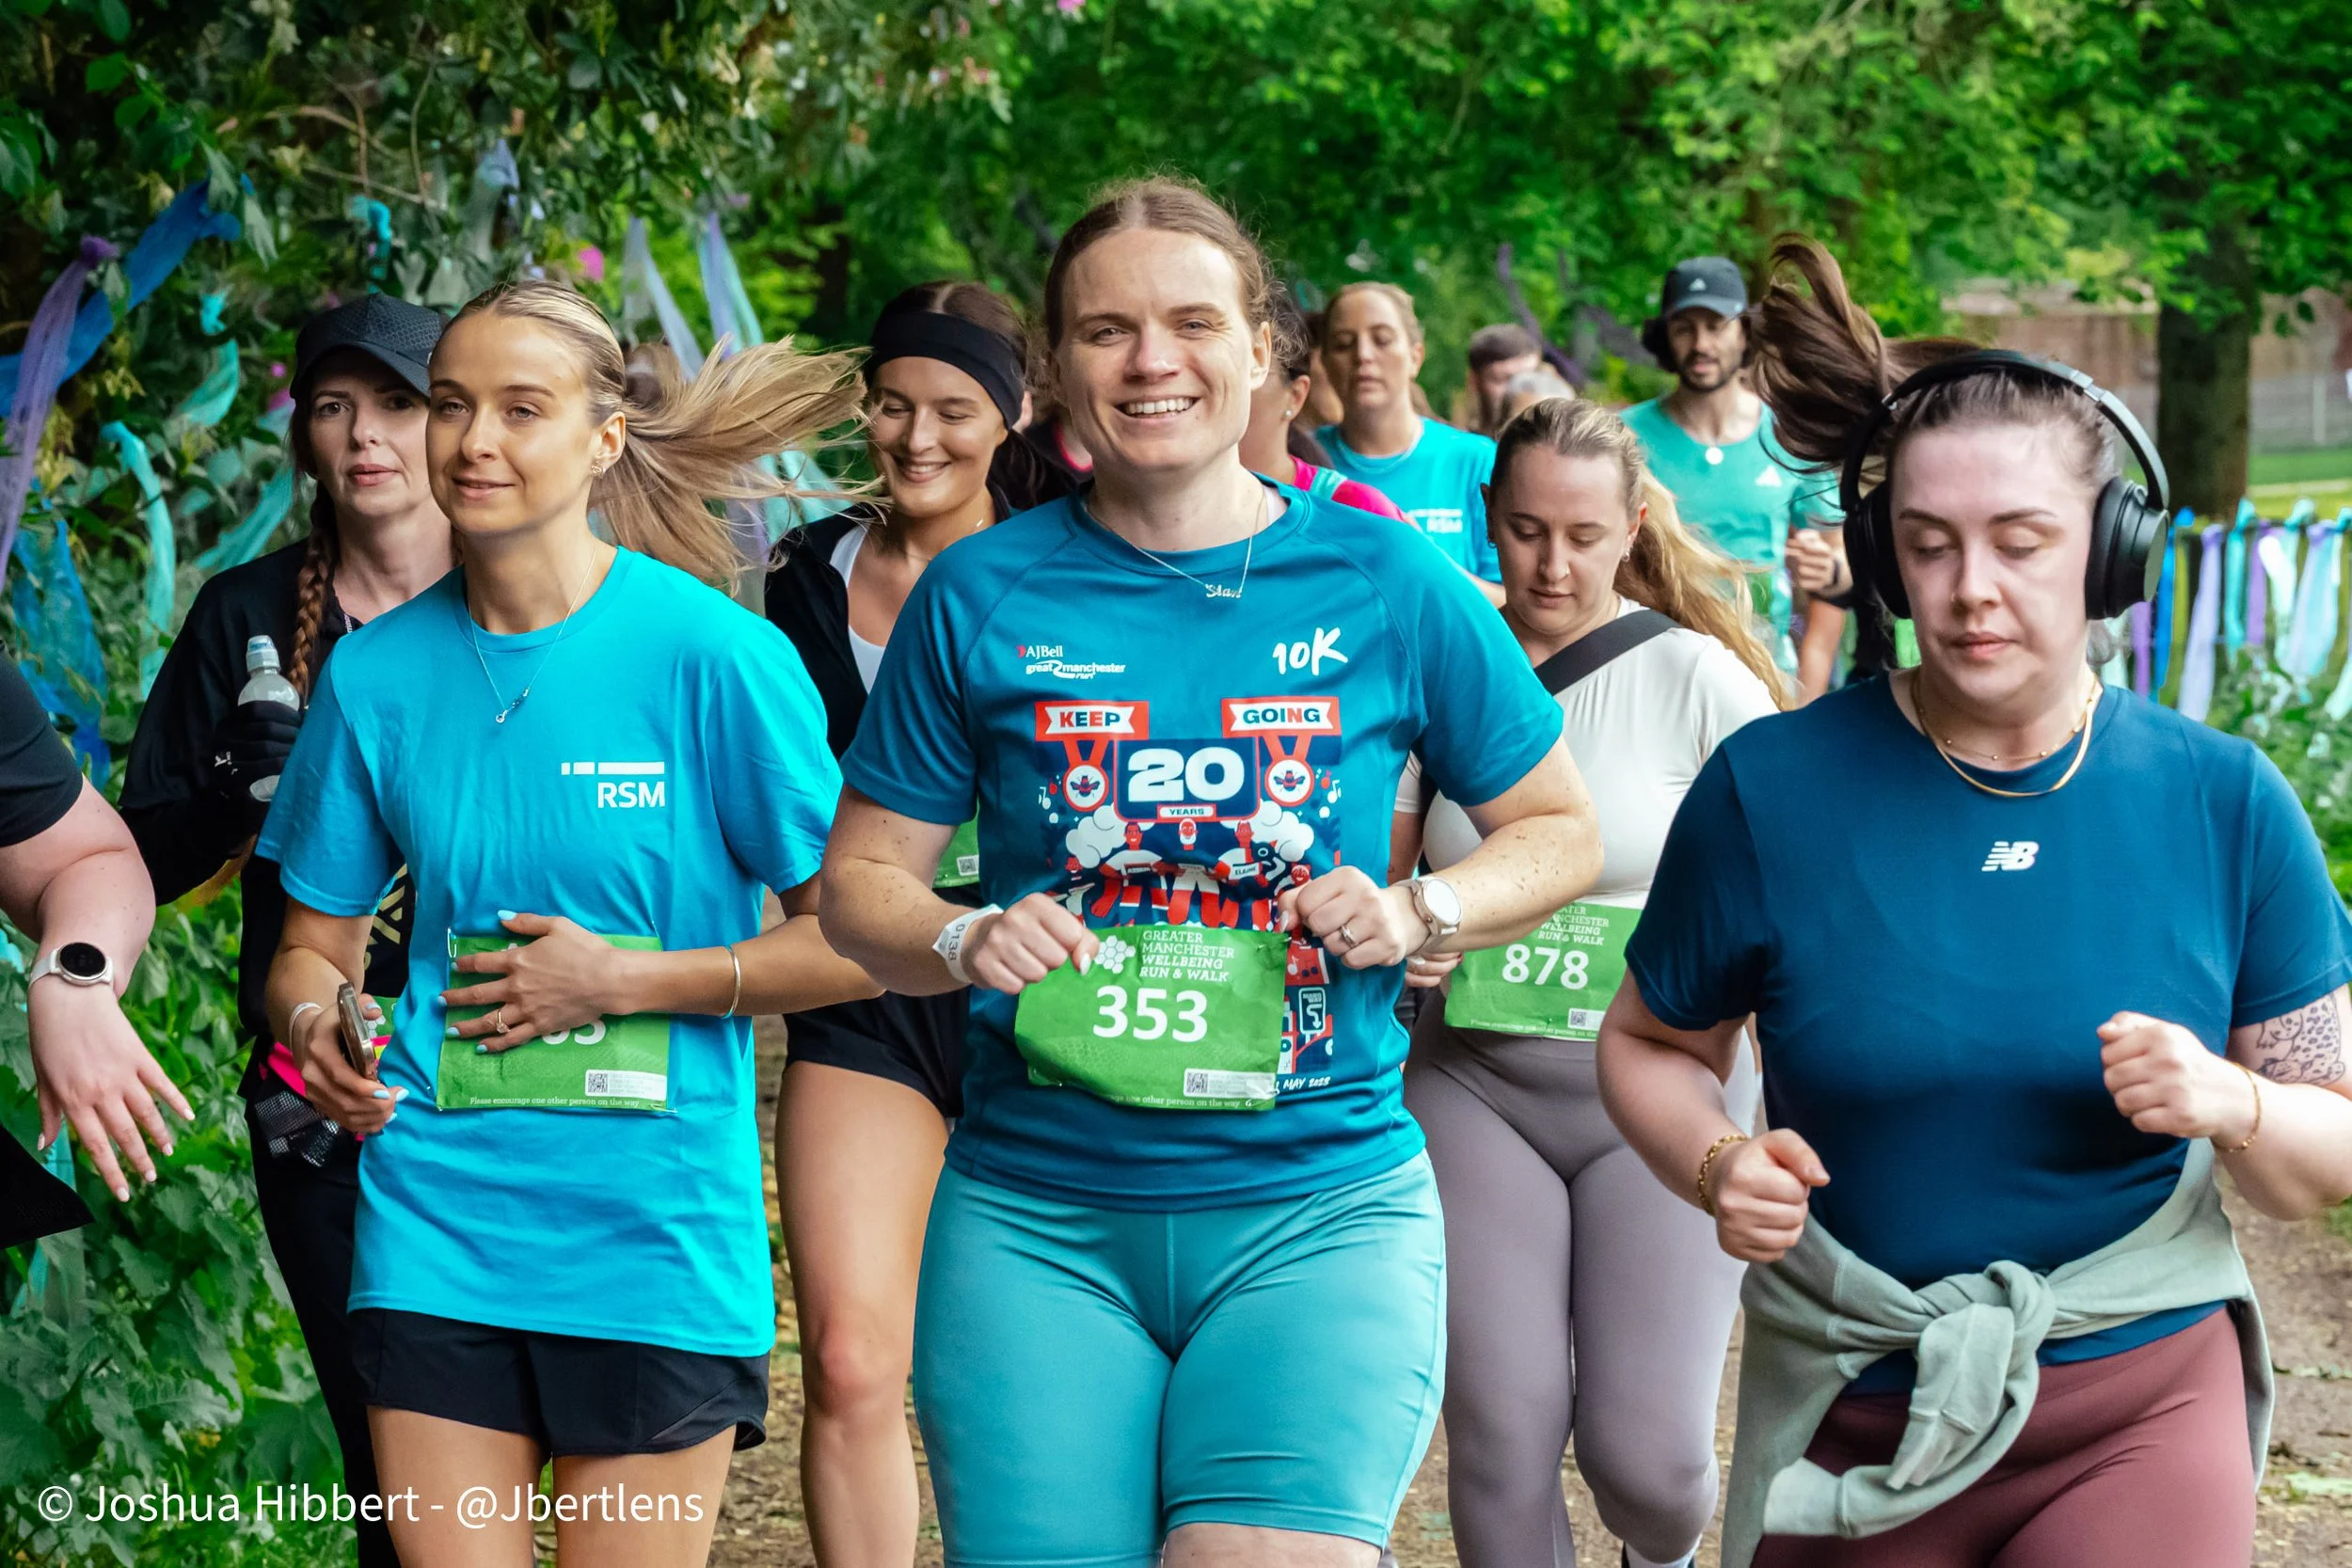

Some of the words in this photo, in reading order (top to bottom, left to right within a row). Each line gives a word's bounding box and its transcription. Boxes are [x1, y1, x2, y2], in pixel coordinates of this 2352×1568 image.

[1272, 626, 1349, 676] 10K
[1062, 661, 1126, 673] manchester
[1059, 710, 1121, 728] KEEP
[1242, 706, 1321, 725] GOING
[1128, 746, 1245, 802] 20
[597, 781, 666, 809] RSM
[1981, 841, 2040, 872] NB
[947, 924, 966, 961] 0138
[1142, 929, 1203, 943] GREATER
[1538, 930, 1562, 941] RUN
[1573, 934, 1605, 946] WALK
[1142, 942, 1235, 958] MANCHESTER
[1142, 954, 1224, 970] WELLBEING
[1502, 942, 1590, 990] 878
[1139, 966, 1170, 978] RUN
[1172, 968, 1183, 979] &
[1186, 969, 1230, 983] WALK
[1092, 985, 1208, 1043] 353
[1282, 1077, 1307, 1090] MAY
[470, 1097, 492, 1105] Please
[547, 1096, 567, 1105] other
[569, 1099, 596, 1107] person
[1142, 1095, 1164, 1104] other
[1166, 1098, 1195, 1106] person
[1209, 1098, 1222, 1106] the
[1223, 1100, 1241, 1109] way
